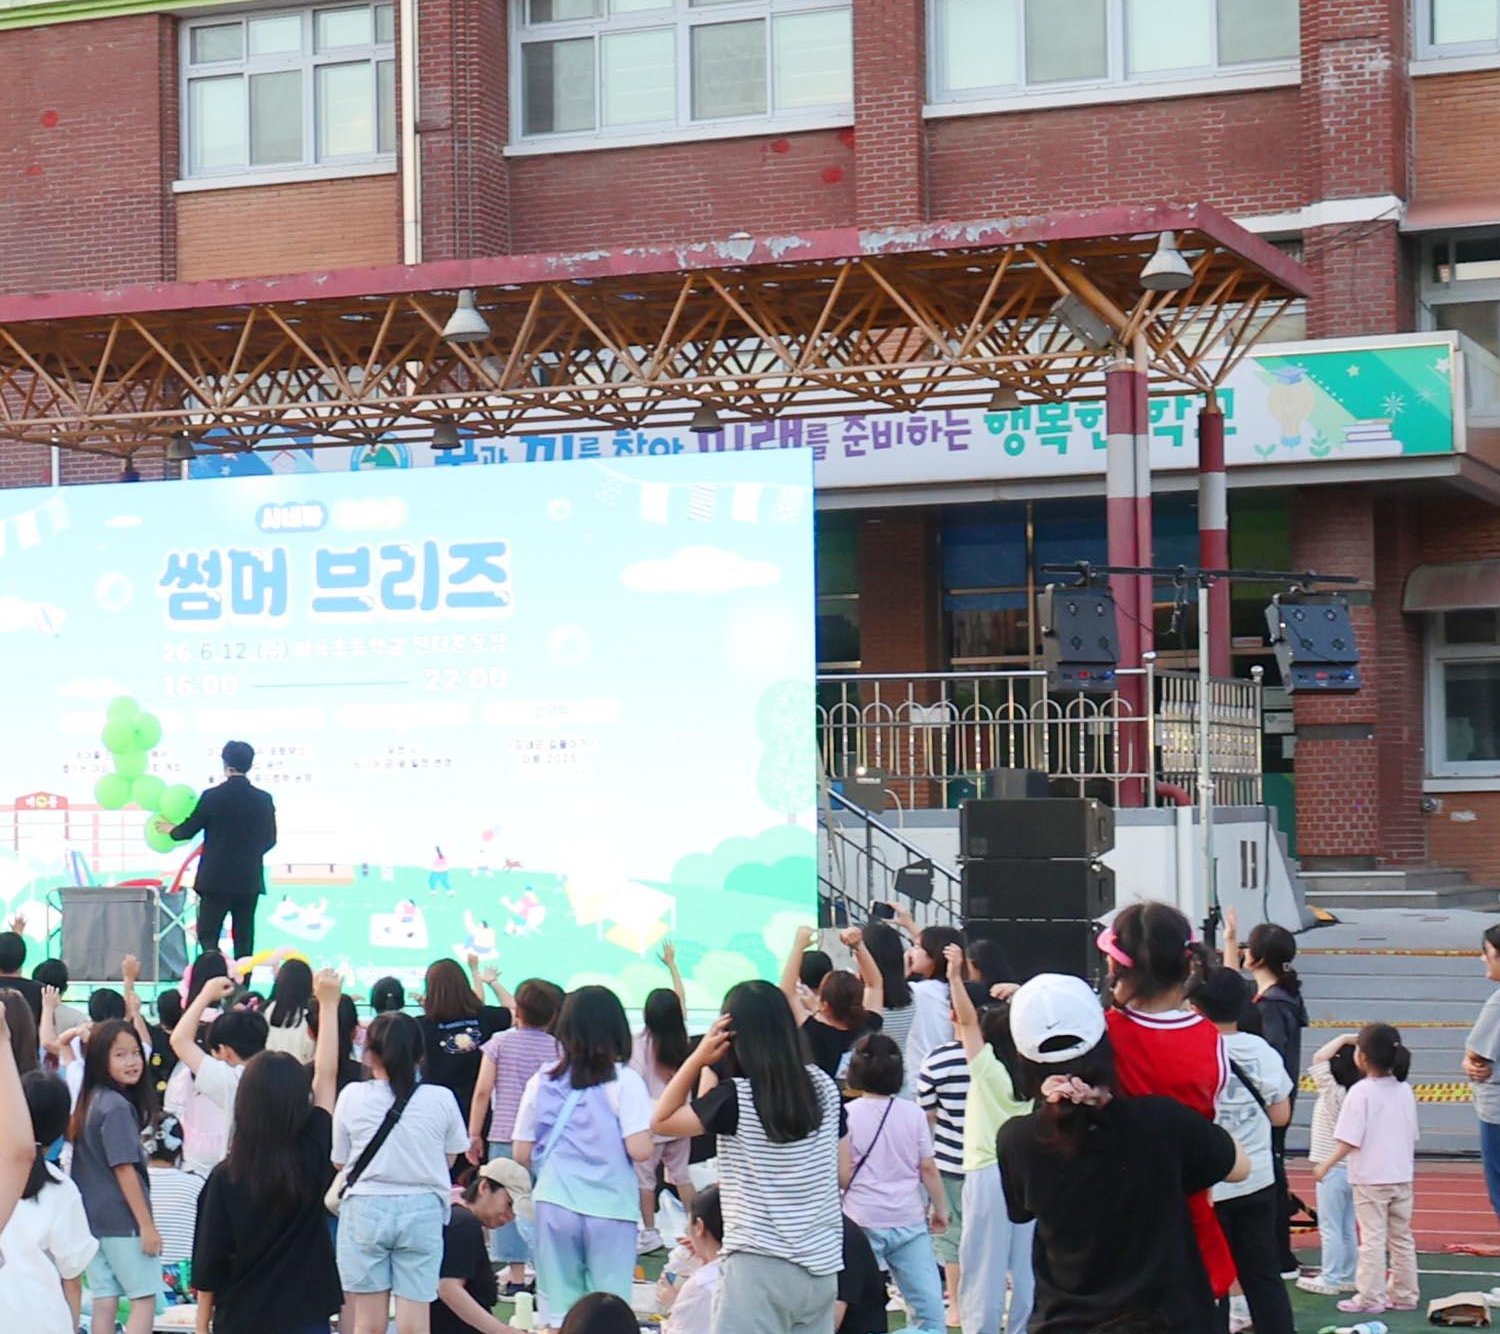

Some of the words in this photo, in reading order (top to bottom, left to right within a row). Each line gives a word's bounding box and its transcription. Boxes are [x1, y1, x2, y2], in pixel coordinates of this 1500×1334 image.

[841, 410, 973, 457] 준비하는
[159, 546, 288, 621] 썸머
[311, 540, 510, 613] 브리즈
